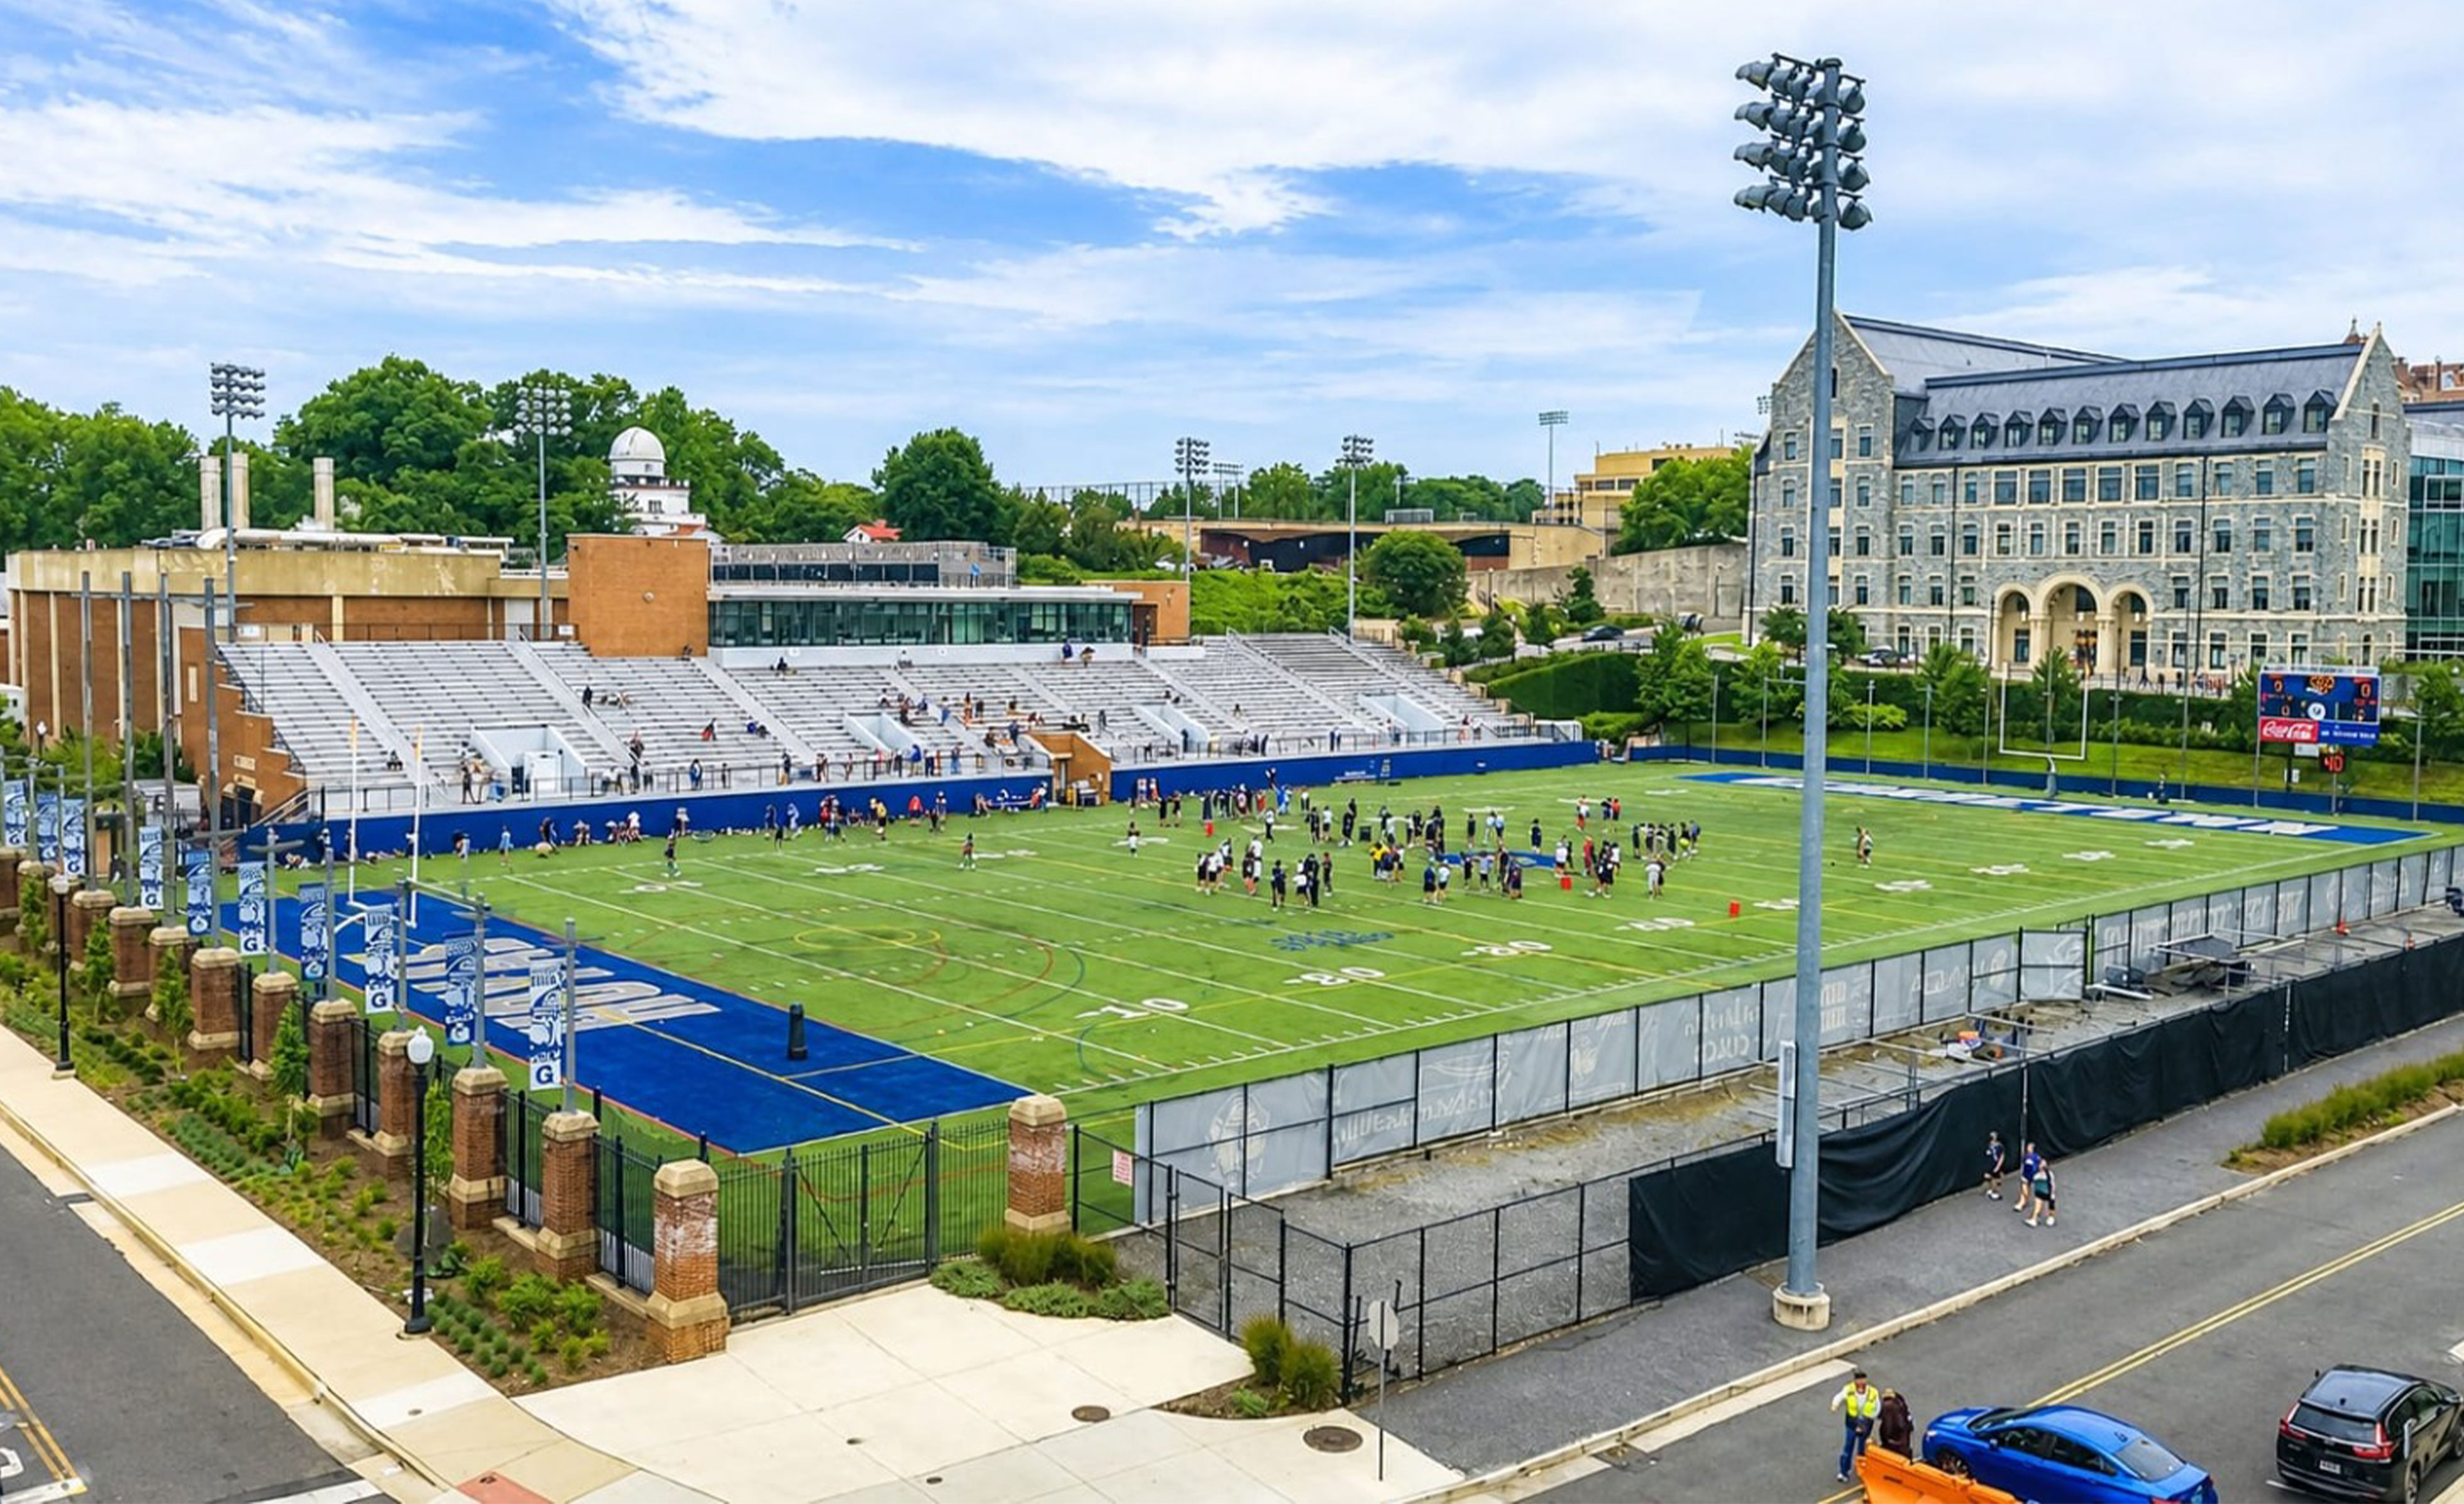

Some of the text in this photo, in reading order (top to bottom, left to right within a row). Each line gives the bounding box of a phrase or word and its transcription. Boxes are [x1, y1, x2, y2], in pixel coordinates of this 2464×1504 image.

[2361, 684, 2371, 698] 0
[2324, 755, 2343, 772] 40
[145, 894, 157, 905] G
[245, 937, 258, 951] G
[372, 992, 387, 1008] G
[536, 1065, 555, 1085] G
